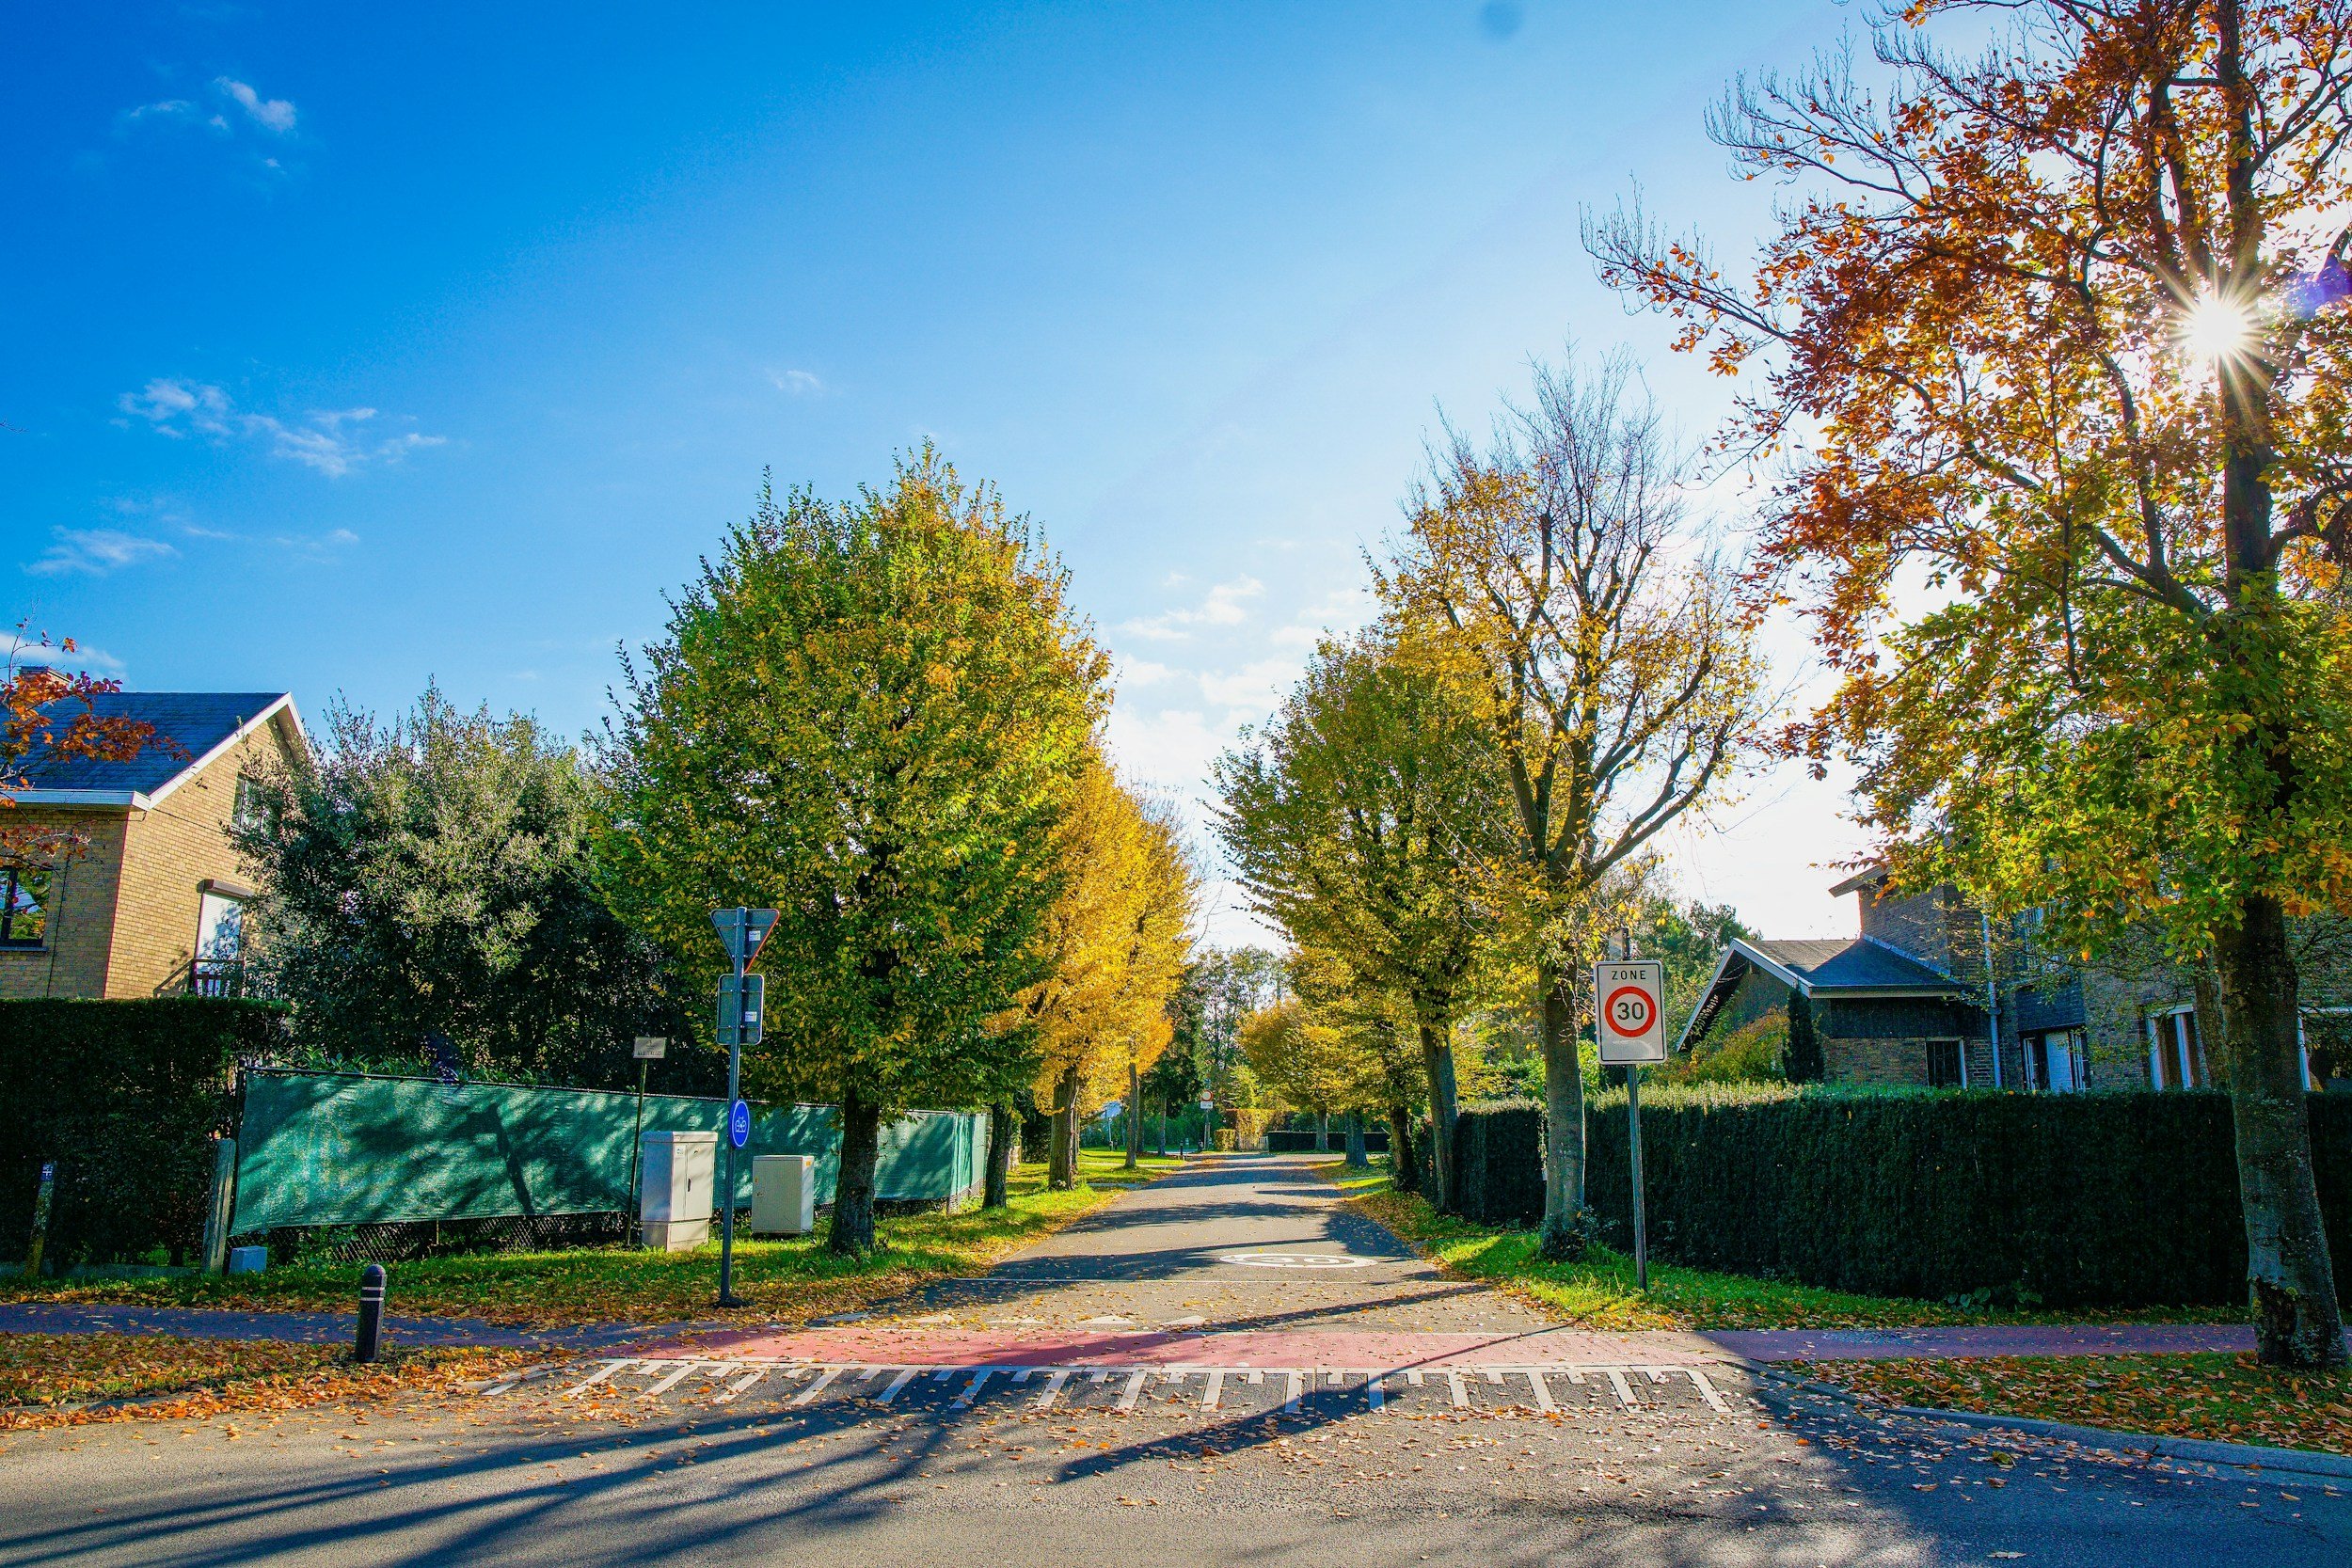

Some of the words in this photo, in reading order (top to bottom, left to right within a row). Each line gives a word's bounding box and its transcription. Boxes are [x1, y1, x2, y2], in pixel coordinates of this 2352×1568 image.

[1612, 970, 1646, 980] ZONE
[1617, 1002, 1645, 1021] 30
[1260, 1256, 1341, 1264] 30
